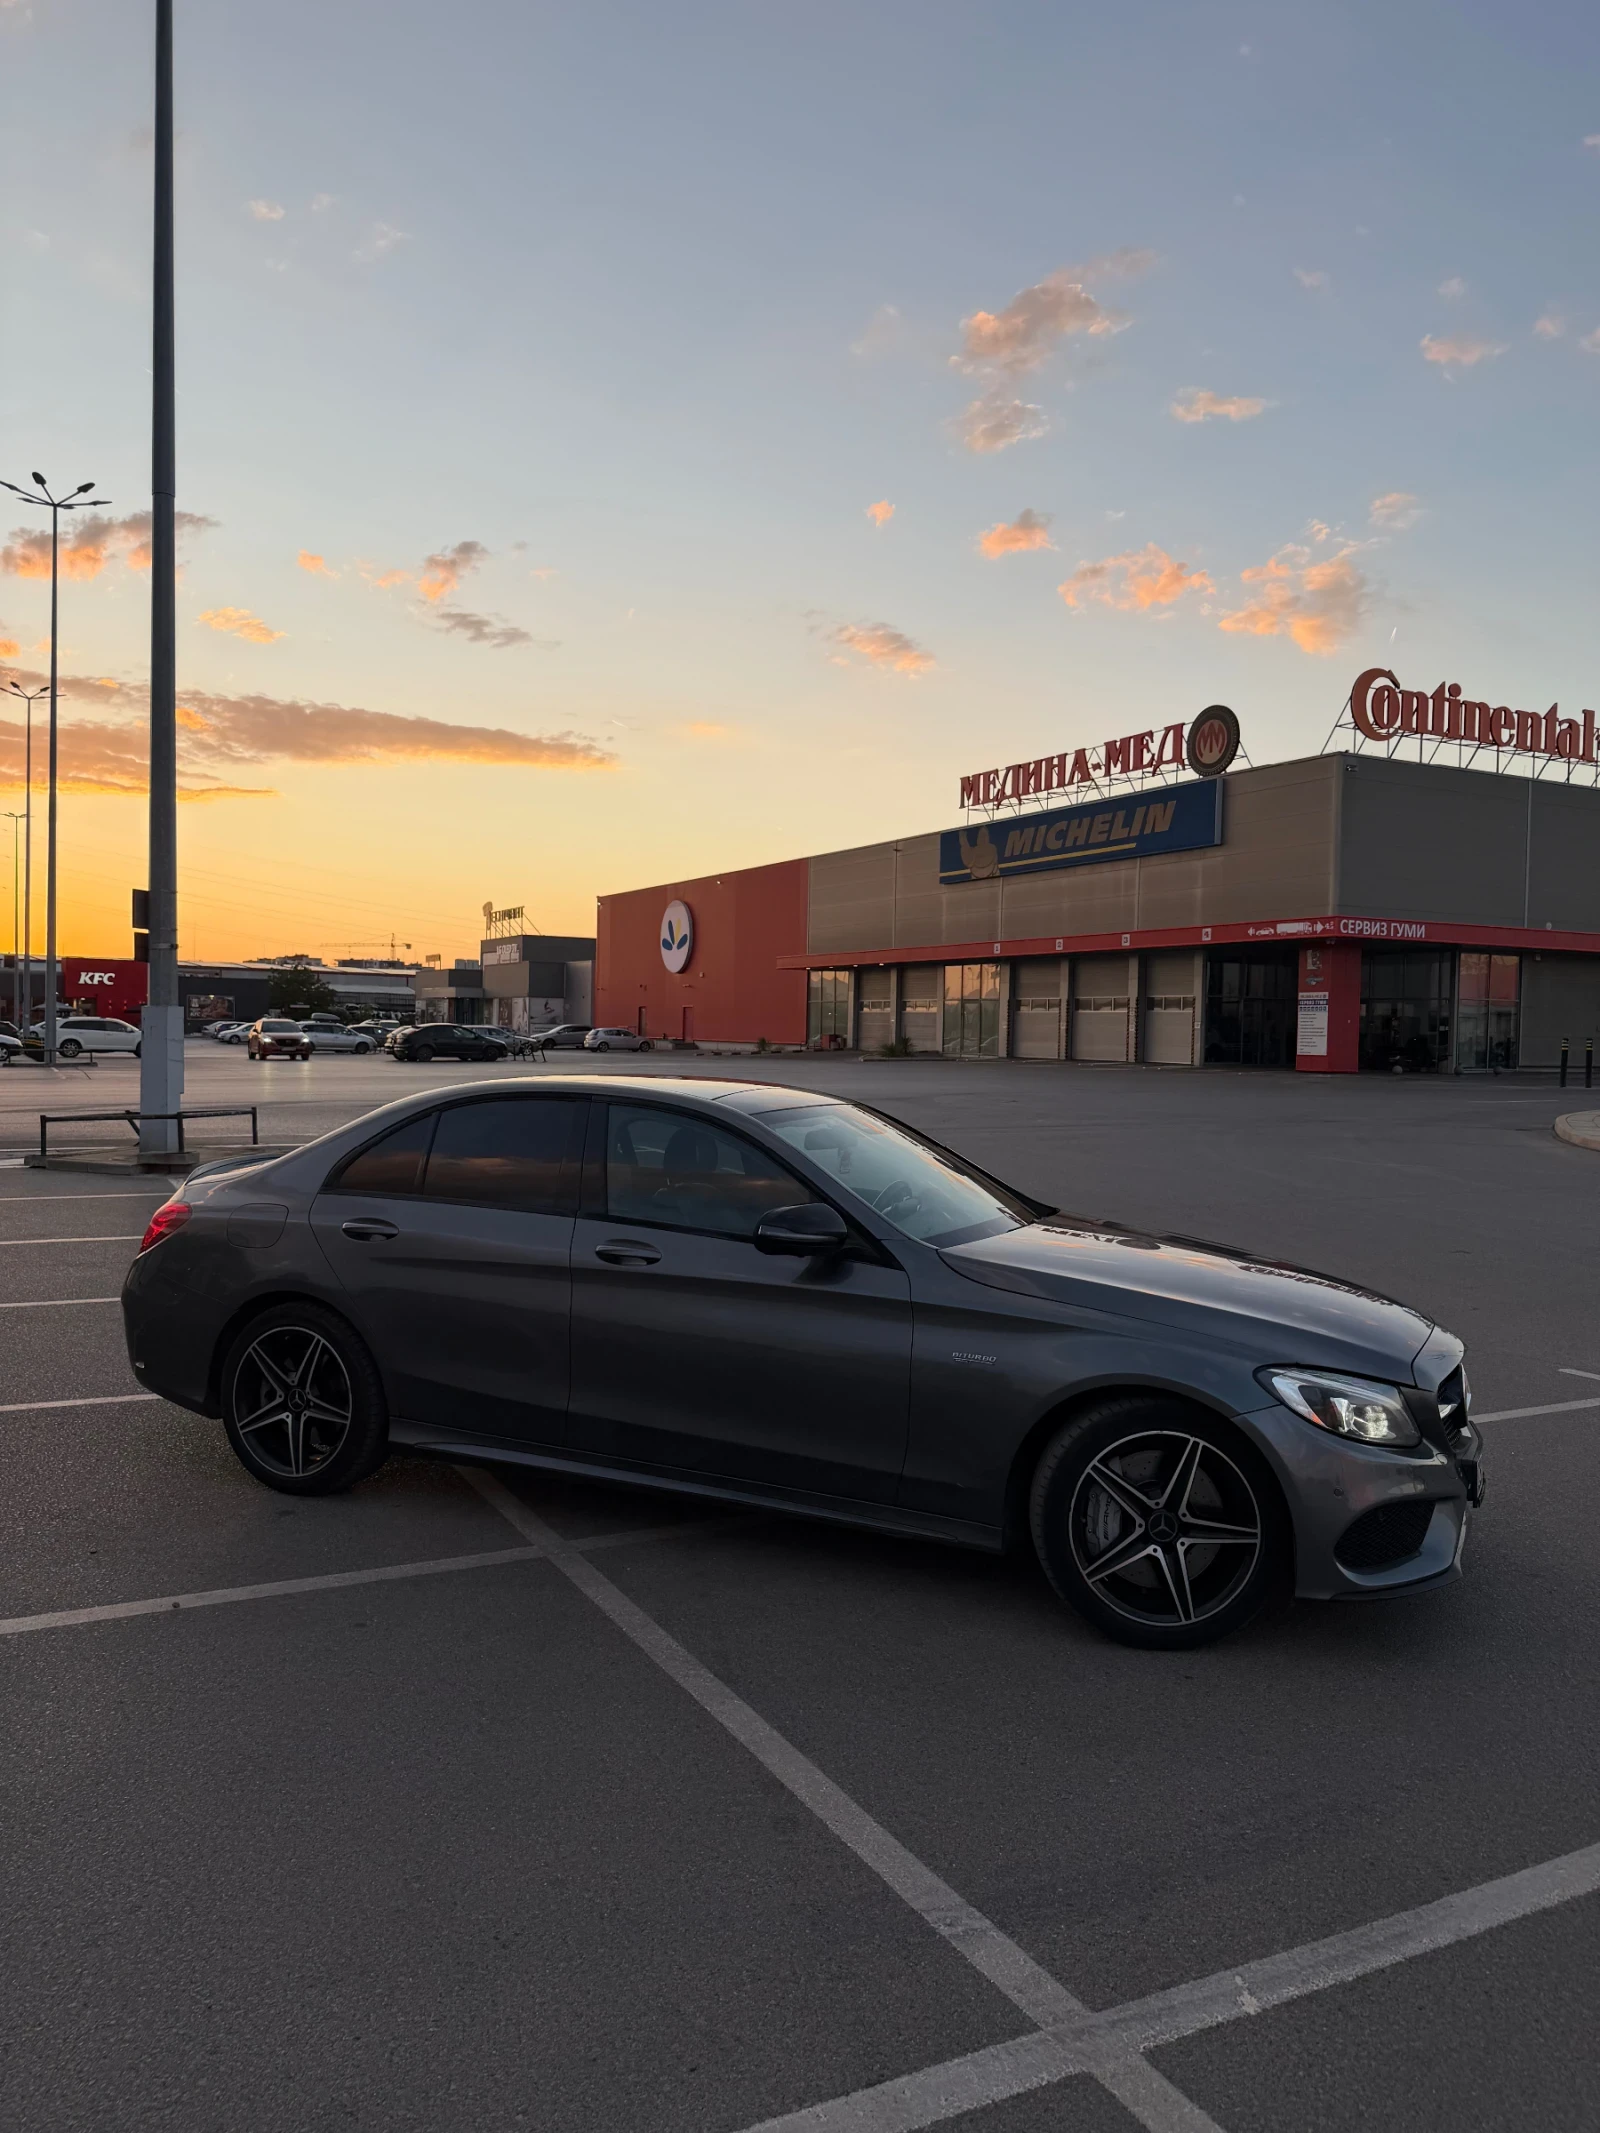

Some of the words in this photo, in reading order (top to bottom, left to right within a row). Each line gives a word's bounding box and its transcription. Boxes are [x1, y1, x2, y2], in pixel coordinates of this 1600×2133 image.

[1351, 667, 1596, 762] Continental
[959, 723, 1186, 809] МЕДИНА-МЕД
[1004, 801, 1176, 857] MICHELIN
[1340, 918, 1387, 936] СЕРВИЗ
[1390, 922, 1426, 939] ГУМИ
[78, 971, 115, 986] KFC
[952, 1352, 997, 1363] BITURBO
